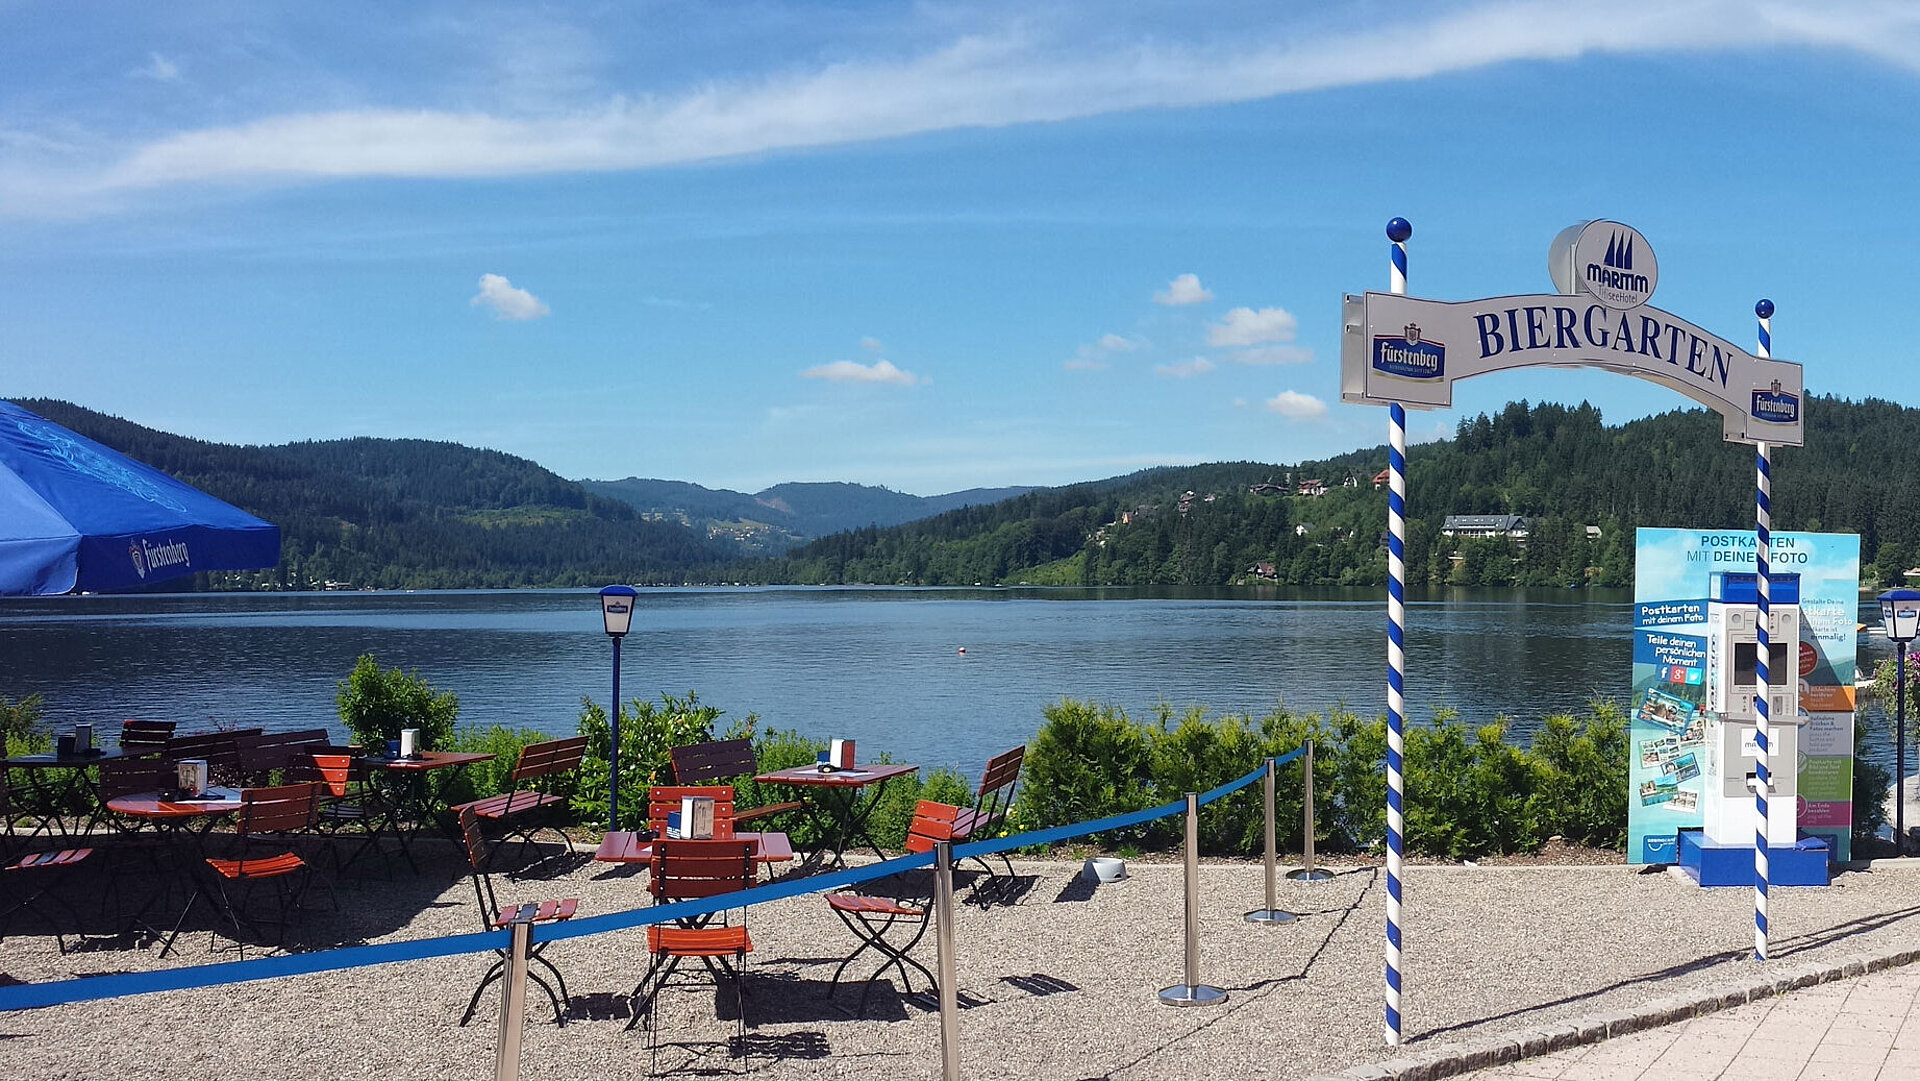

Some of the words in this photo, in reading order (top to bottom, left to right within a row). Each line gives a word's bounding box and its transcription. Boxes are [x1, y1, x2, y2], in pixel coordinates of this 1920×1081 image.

[1587, 263, 1648, 293] MARITIM
[1473, 304, 1734, 390] BIERGARTEN
[1701, 535, 1795, 548] POSTKATEN
[1687, 550, 1709, 562] MIT
[1713, 550, 1758, 563] DEINE
[1771, 552, 1808, 564] FOTO
[1641, 604, 1700, 616] Postkarten
[1643, 616, 1656, 625] mit
[1657, 615, 1684, 624] deinem
[1684, 613, 1704, 623] Foto
[1646, 633, 1668, 645] Teile
[1669, 636, 1697, 648] deinen
[1655, 646, 1706, 659] persönlichen
[1662, 655, 1699, 667] Moment
